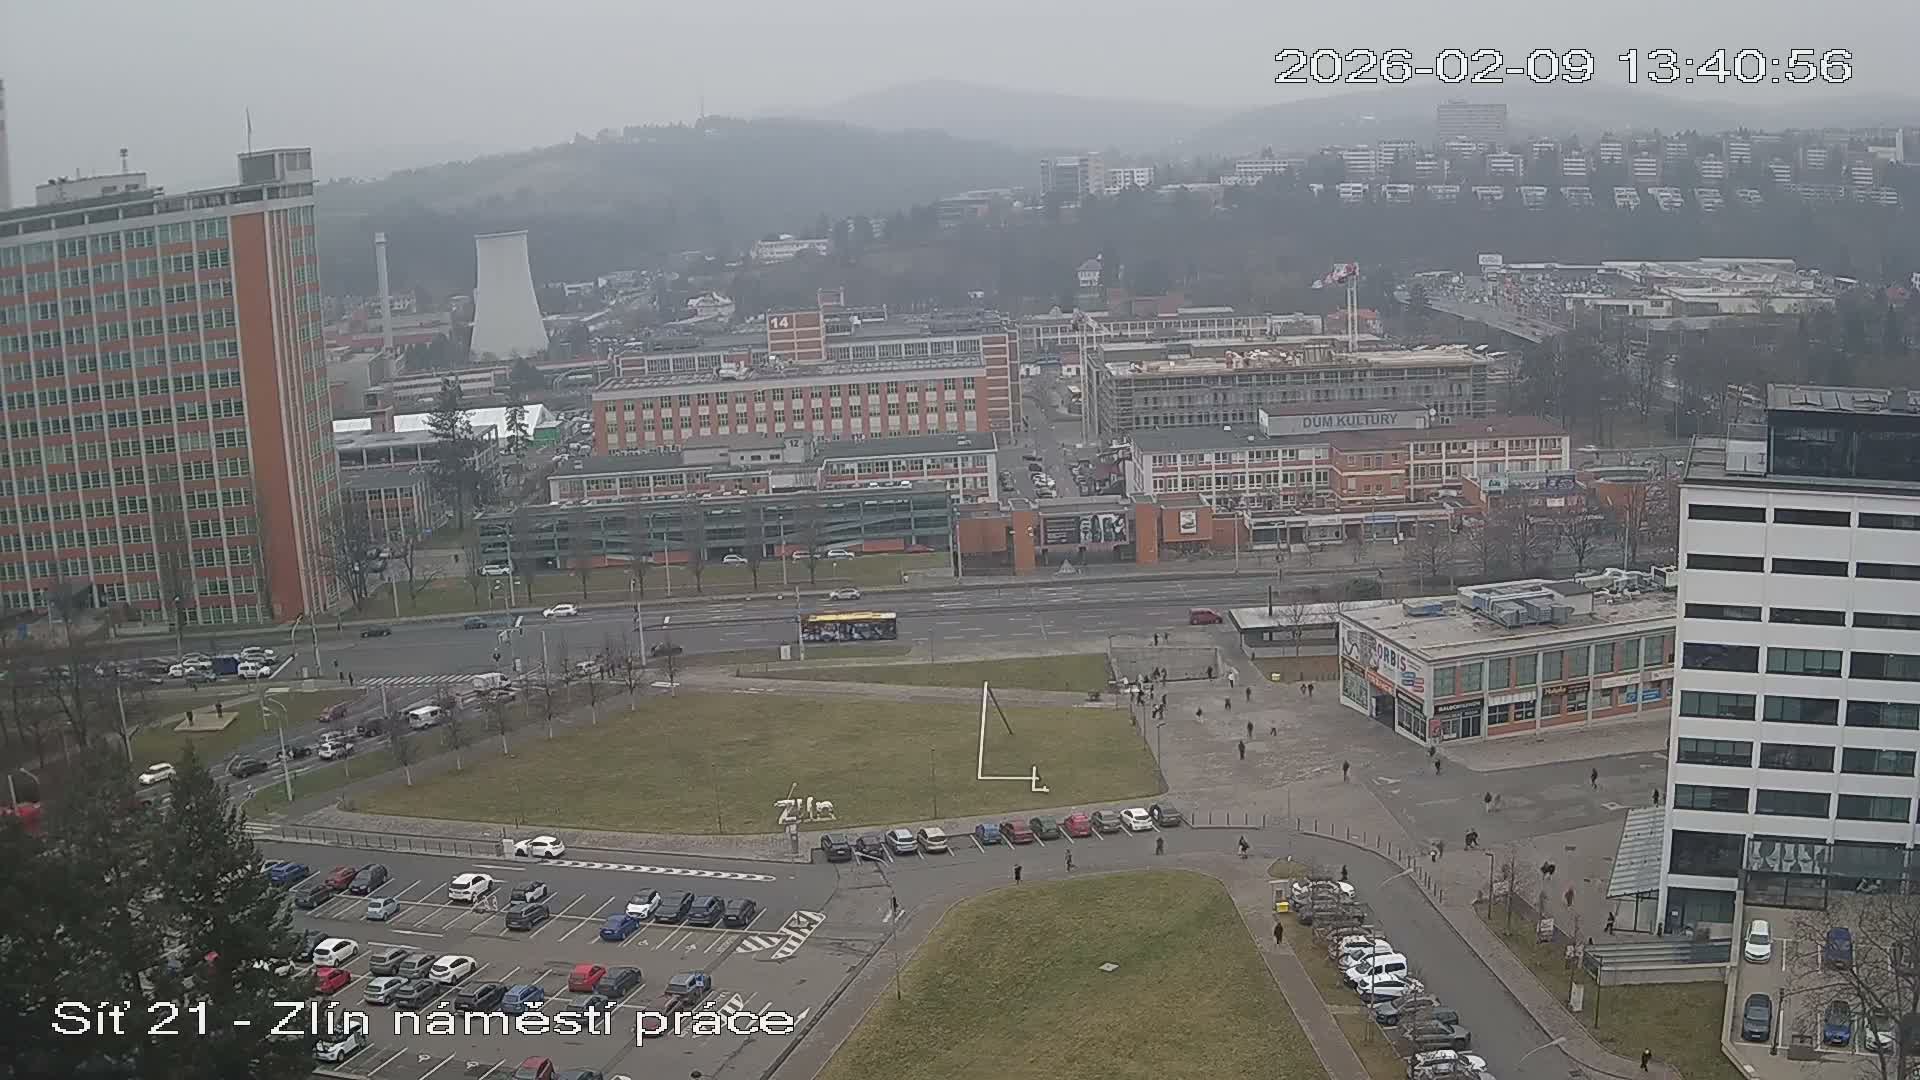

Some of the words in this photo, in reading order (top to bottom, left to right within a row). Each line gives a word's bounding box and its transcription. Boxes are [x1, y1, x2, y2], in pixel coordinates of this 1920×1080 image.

[770, 316, 789, 329] 14
[1337, 412, 1398, 427] KULTURY
[1377, 643, 1407, 672] ORBIS
